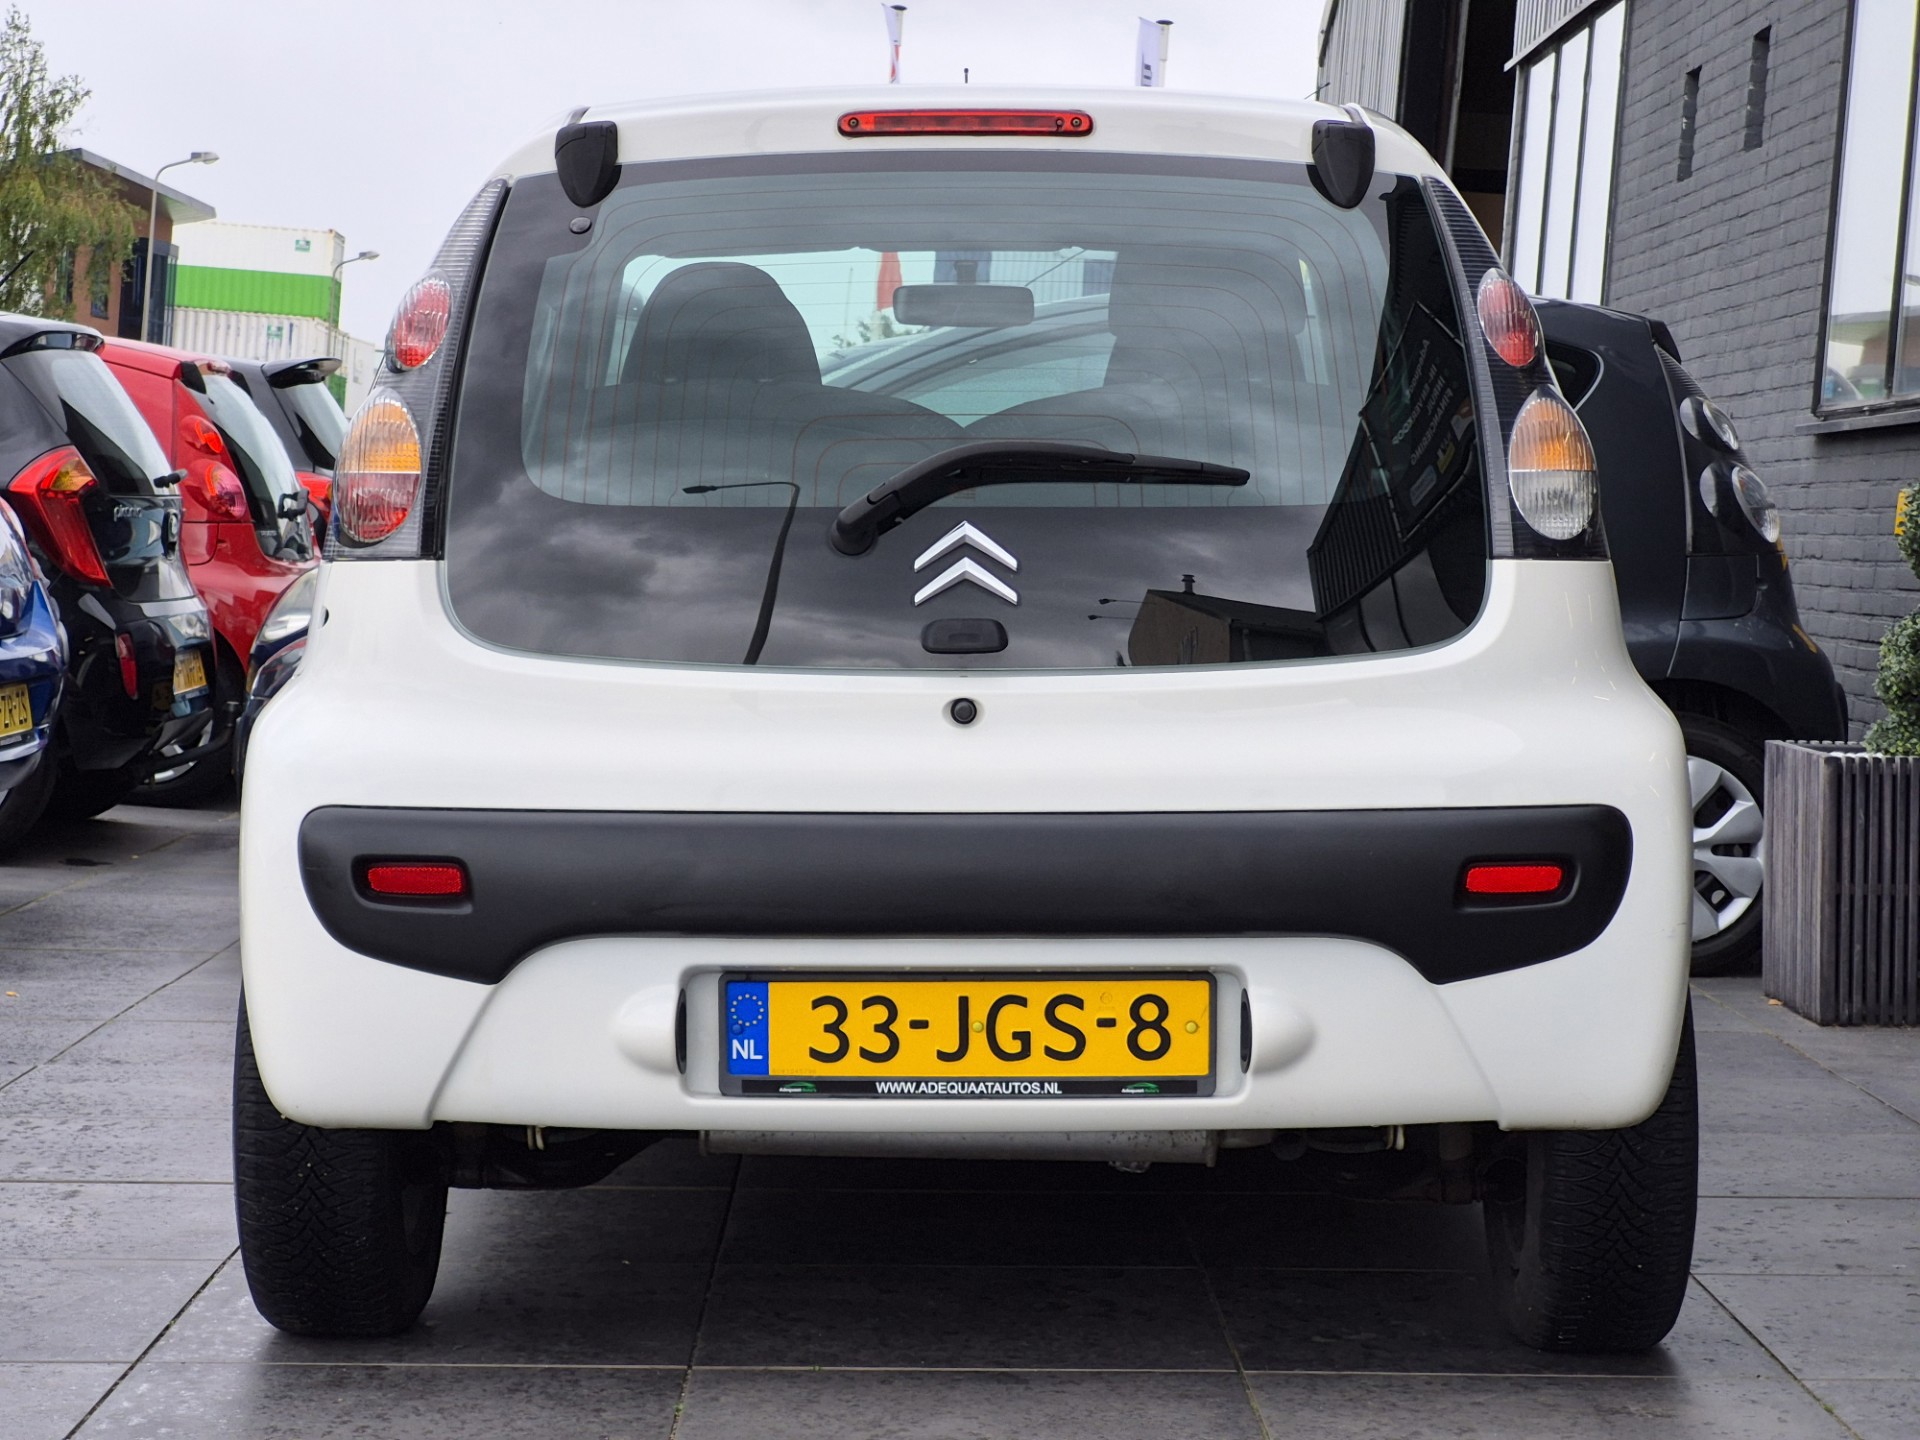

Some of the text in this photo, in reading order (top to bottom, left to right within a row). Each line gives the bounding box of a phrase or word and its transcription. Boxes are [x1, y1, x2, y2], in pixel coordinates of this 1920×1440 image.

[808, 993, 1172, 1063] 33-JGS-8
[732, 1039, 763, 1060] NL
[875, 1081, 1062, 1095] WWW.ADEQUAATAUTOS.NL
